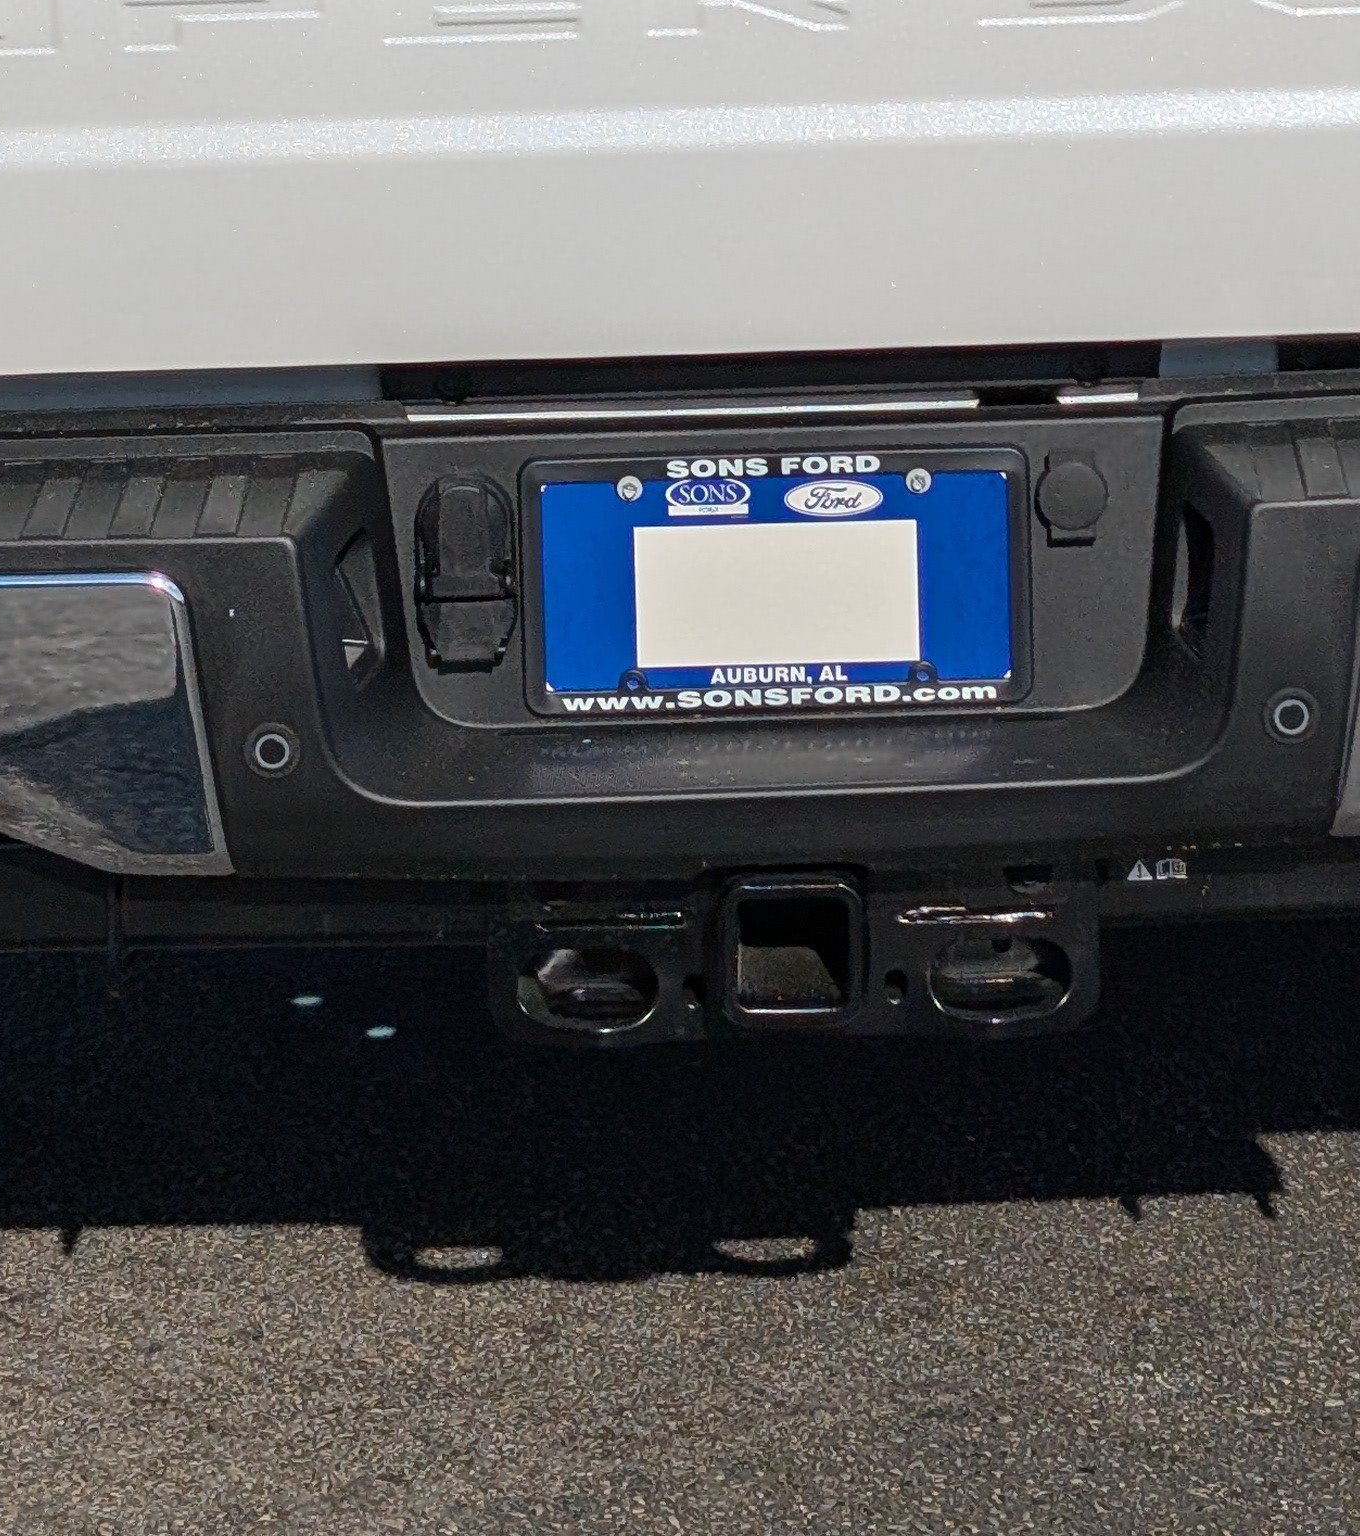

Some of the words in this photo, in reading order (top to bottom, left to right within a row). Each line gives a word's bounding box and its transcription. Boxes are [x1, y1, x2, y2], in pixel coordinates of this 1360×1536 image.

[666, 458, 769, 479] SONS
[781, 455, 881, 475] FORD
[678, 483, 738, 504] SONS
[804, 486, 863, 509] Ford
[710, 666, 813, 685] AUBURN,
[819, 664, 848, 681] AL
[562, 683, 997, 712] www.SONSFORD.com
